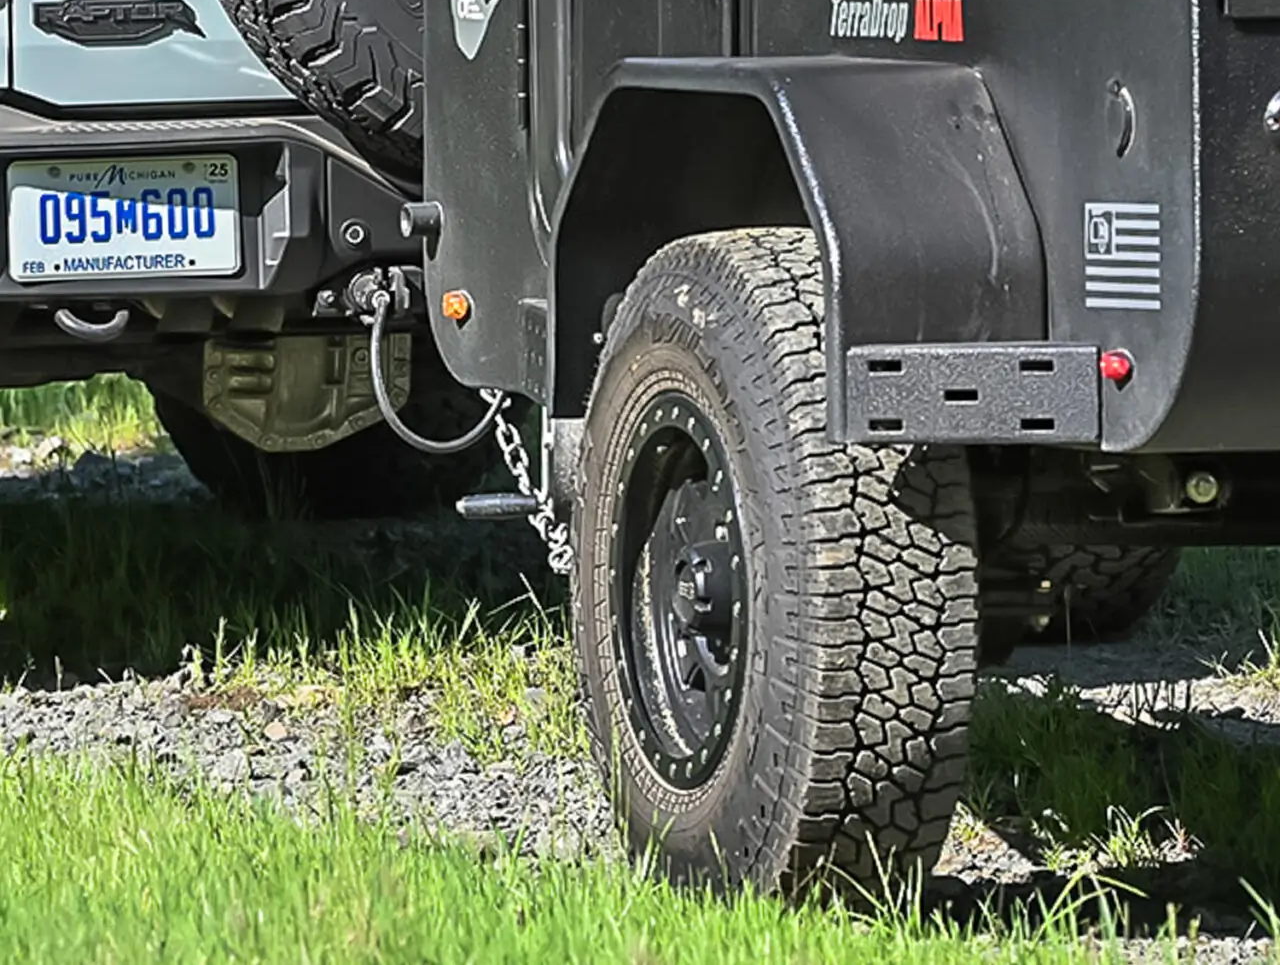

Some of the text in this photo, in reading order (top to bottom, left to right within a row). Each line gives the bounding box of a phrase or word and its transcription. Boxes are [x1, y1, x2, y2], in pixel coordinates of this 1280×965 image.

[69, 164, 176, 188] PURE MICHIGAN
[209, 162, 228, 177] 25
[39, 187, 215, 245] 095M600
[22, 253, 186, 273] FEB MANUFACTURER
